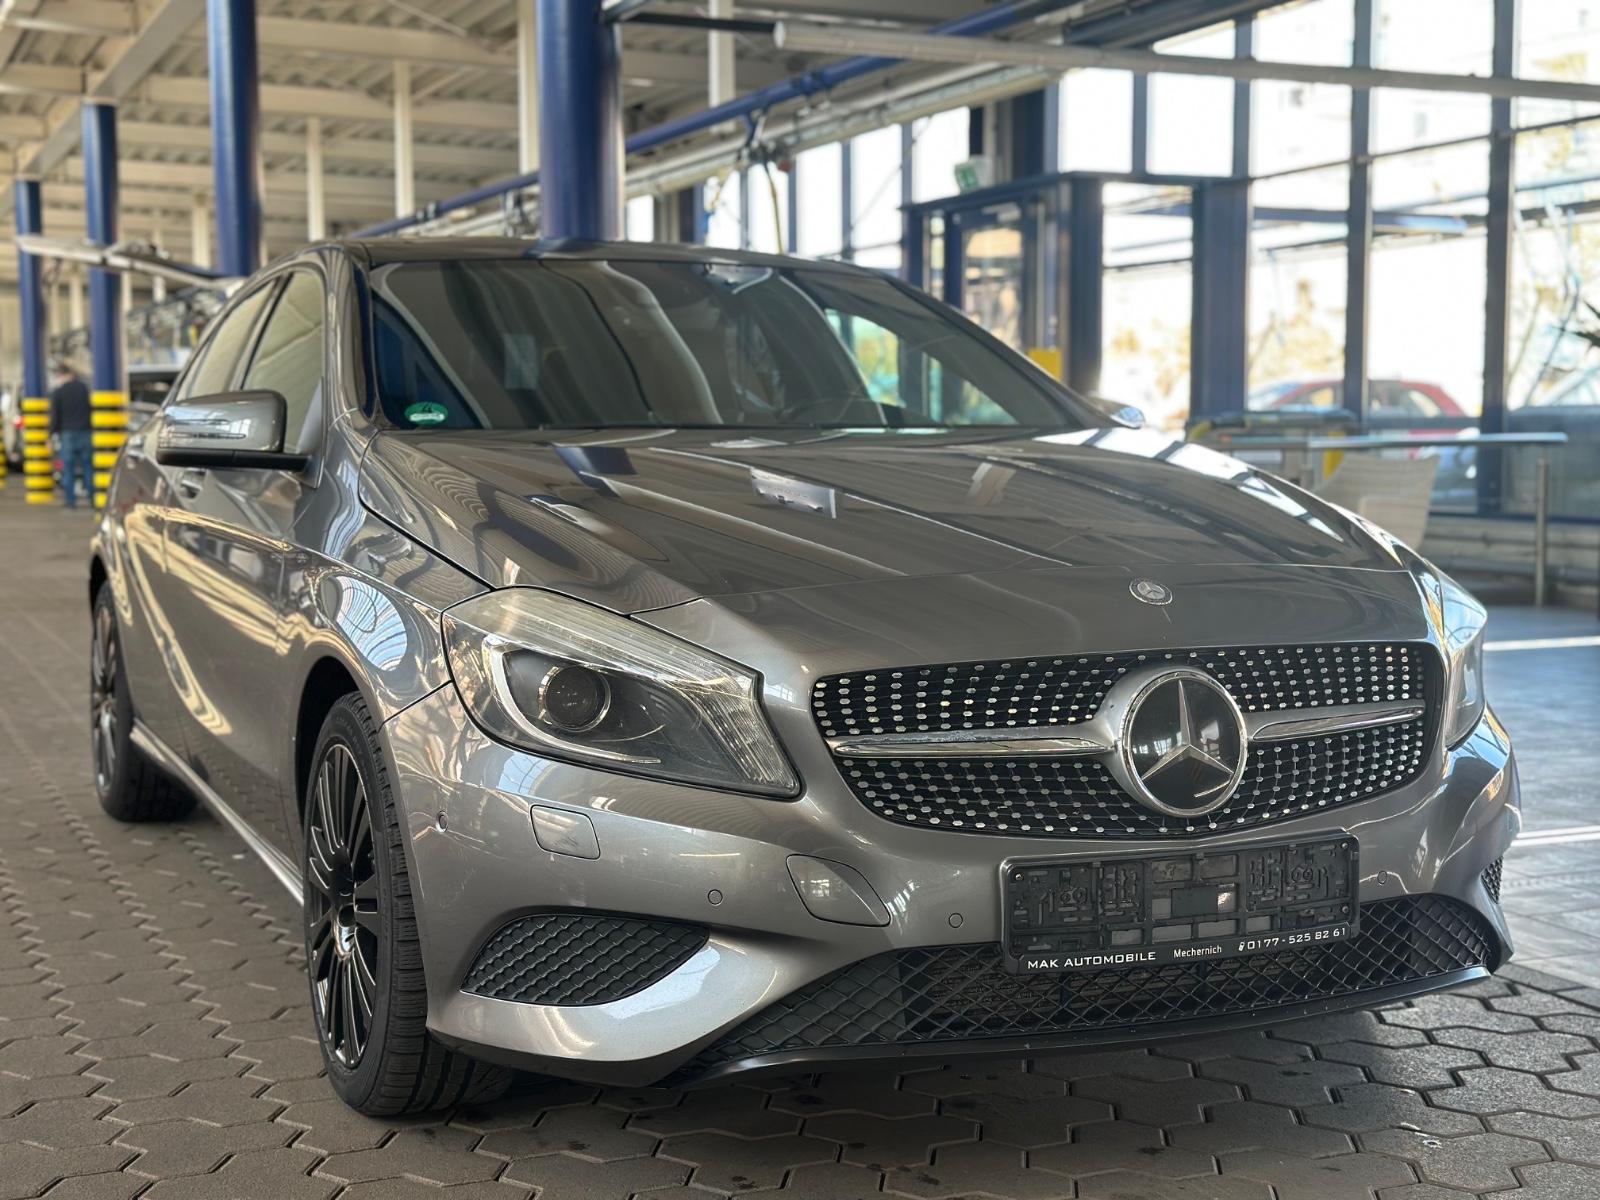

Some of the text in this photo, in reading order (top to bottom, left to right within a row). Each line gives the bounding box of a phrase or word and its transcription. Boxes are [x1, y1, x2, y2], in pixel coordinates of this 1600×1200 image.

[1027, 958, 1059, 970] MAK
[1063, 951, 1157, 968] AUTOMOBILE
[1173, 944, 1222, 959] Mechernich
[1314, 930, 1329, 940] 82
[1332, 927, 1345, 937] 61
